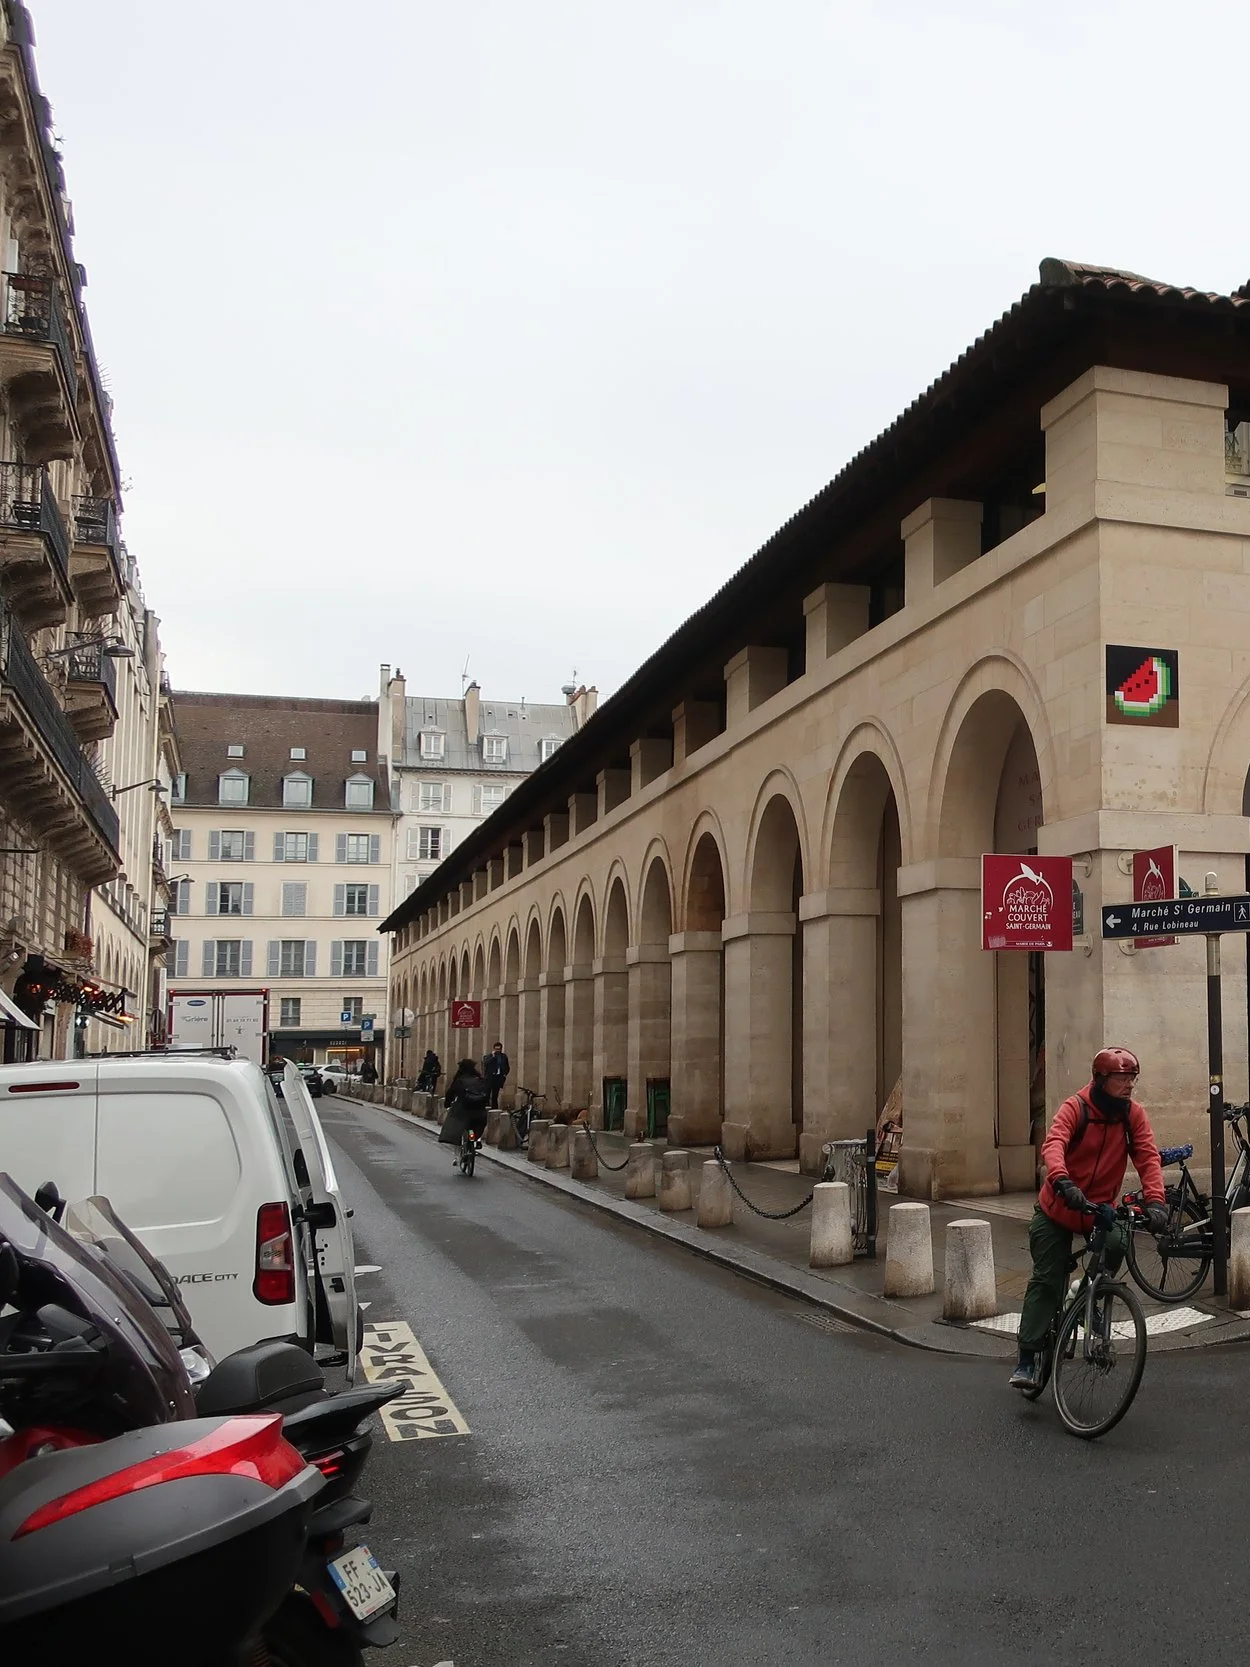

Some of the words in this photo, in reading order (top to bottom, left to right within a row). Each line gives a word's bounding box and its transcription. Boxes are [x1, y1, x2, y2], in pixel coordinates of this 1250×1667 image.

[1009, 903, 1047, 913] MARCHÉ
[1131, 905, 1169, 919] Marché
[1187, 901, 1231, 914] Germain
[1007, 913, 1048, 922] COUVERT
[1005, 922, 1051, 930] SAINT-GERMAIN
[1143, 921, 1159, 931] Rue
[1162, 919, 1199, 930] Lobineau
[214, 1272, 239, 1281] CITY
[362, 1323, 460, 1439] LIVRAISON
[346, 1572, 389, 1608] 523-JA
